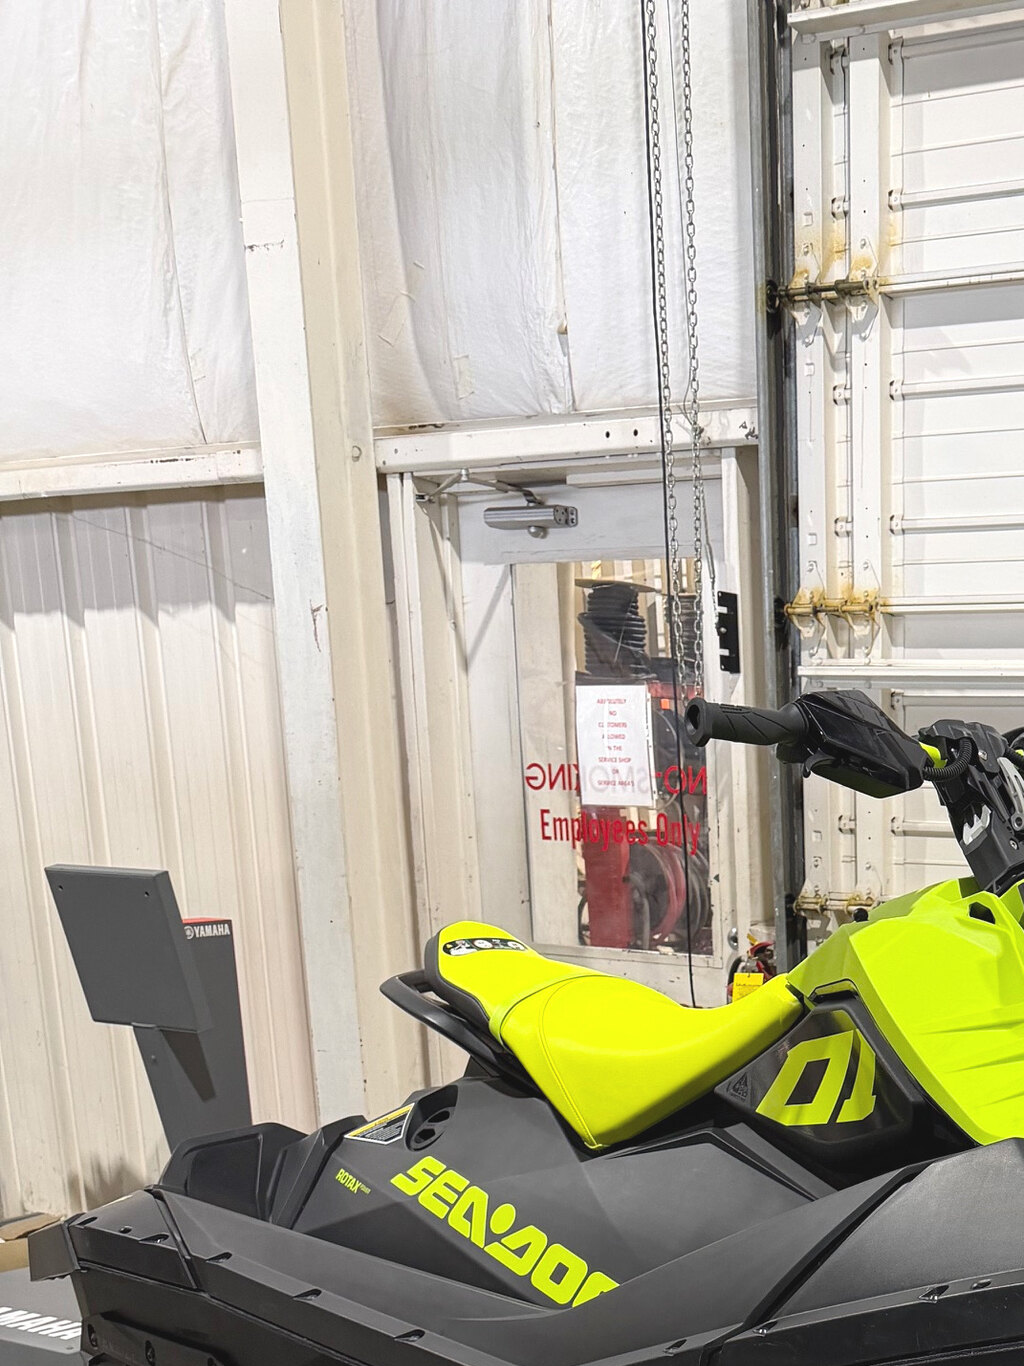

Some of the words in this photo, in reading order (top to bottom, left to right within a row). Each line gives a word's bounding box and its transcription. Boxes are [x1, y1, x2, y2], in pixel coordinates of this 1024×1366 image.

[540, 809, 648, 852] Employees
[656, 812, 700, 856] Only
[193, 924, 231, 938] YAMAHA
[335, 1168, 362, 1194] ROTAX
[0, 1306, 82, 1341] MAHA
